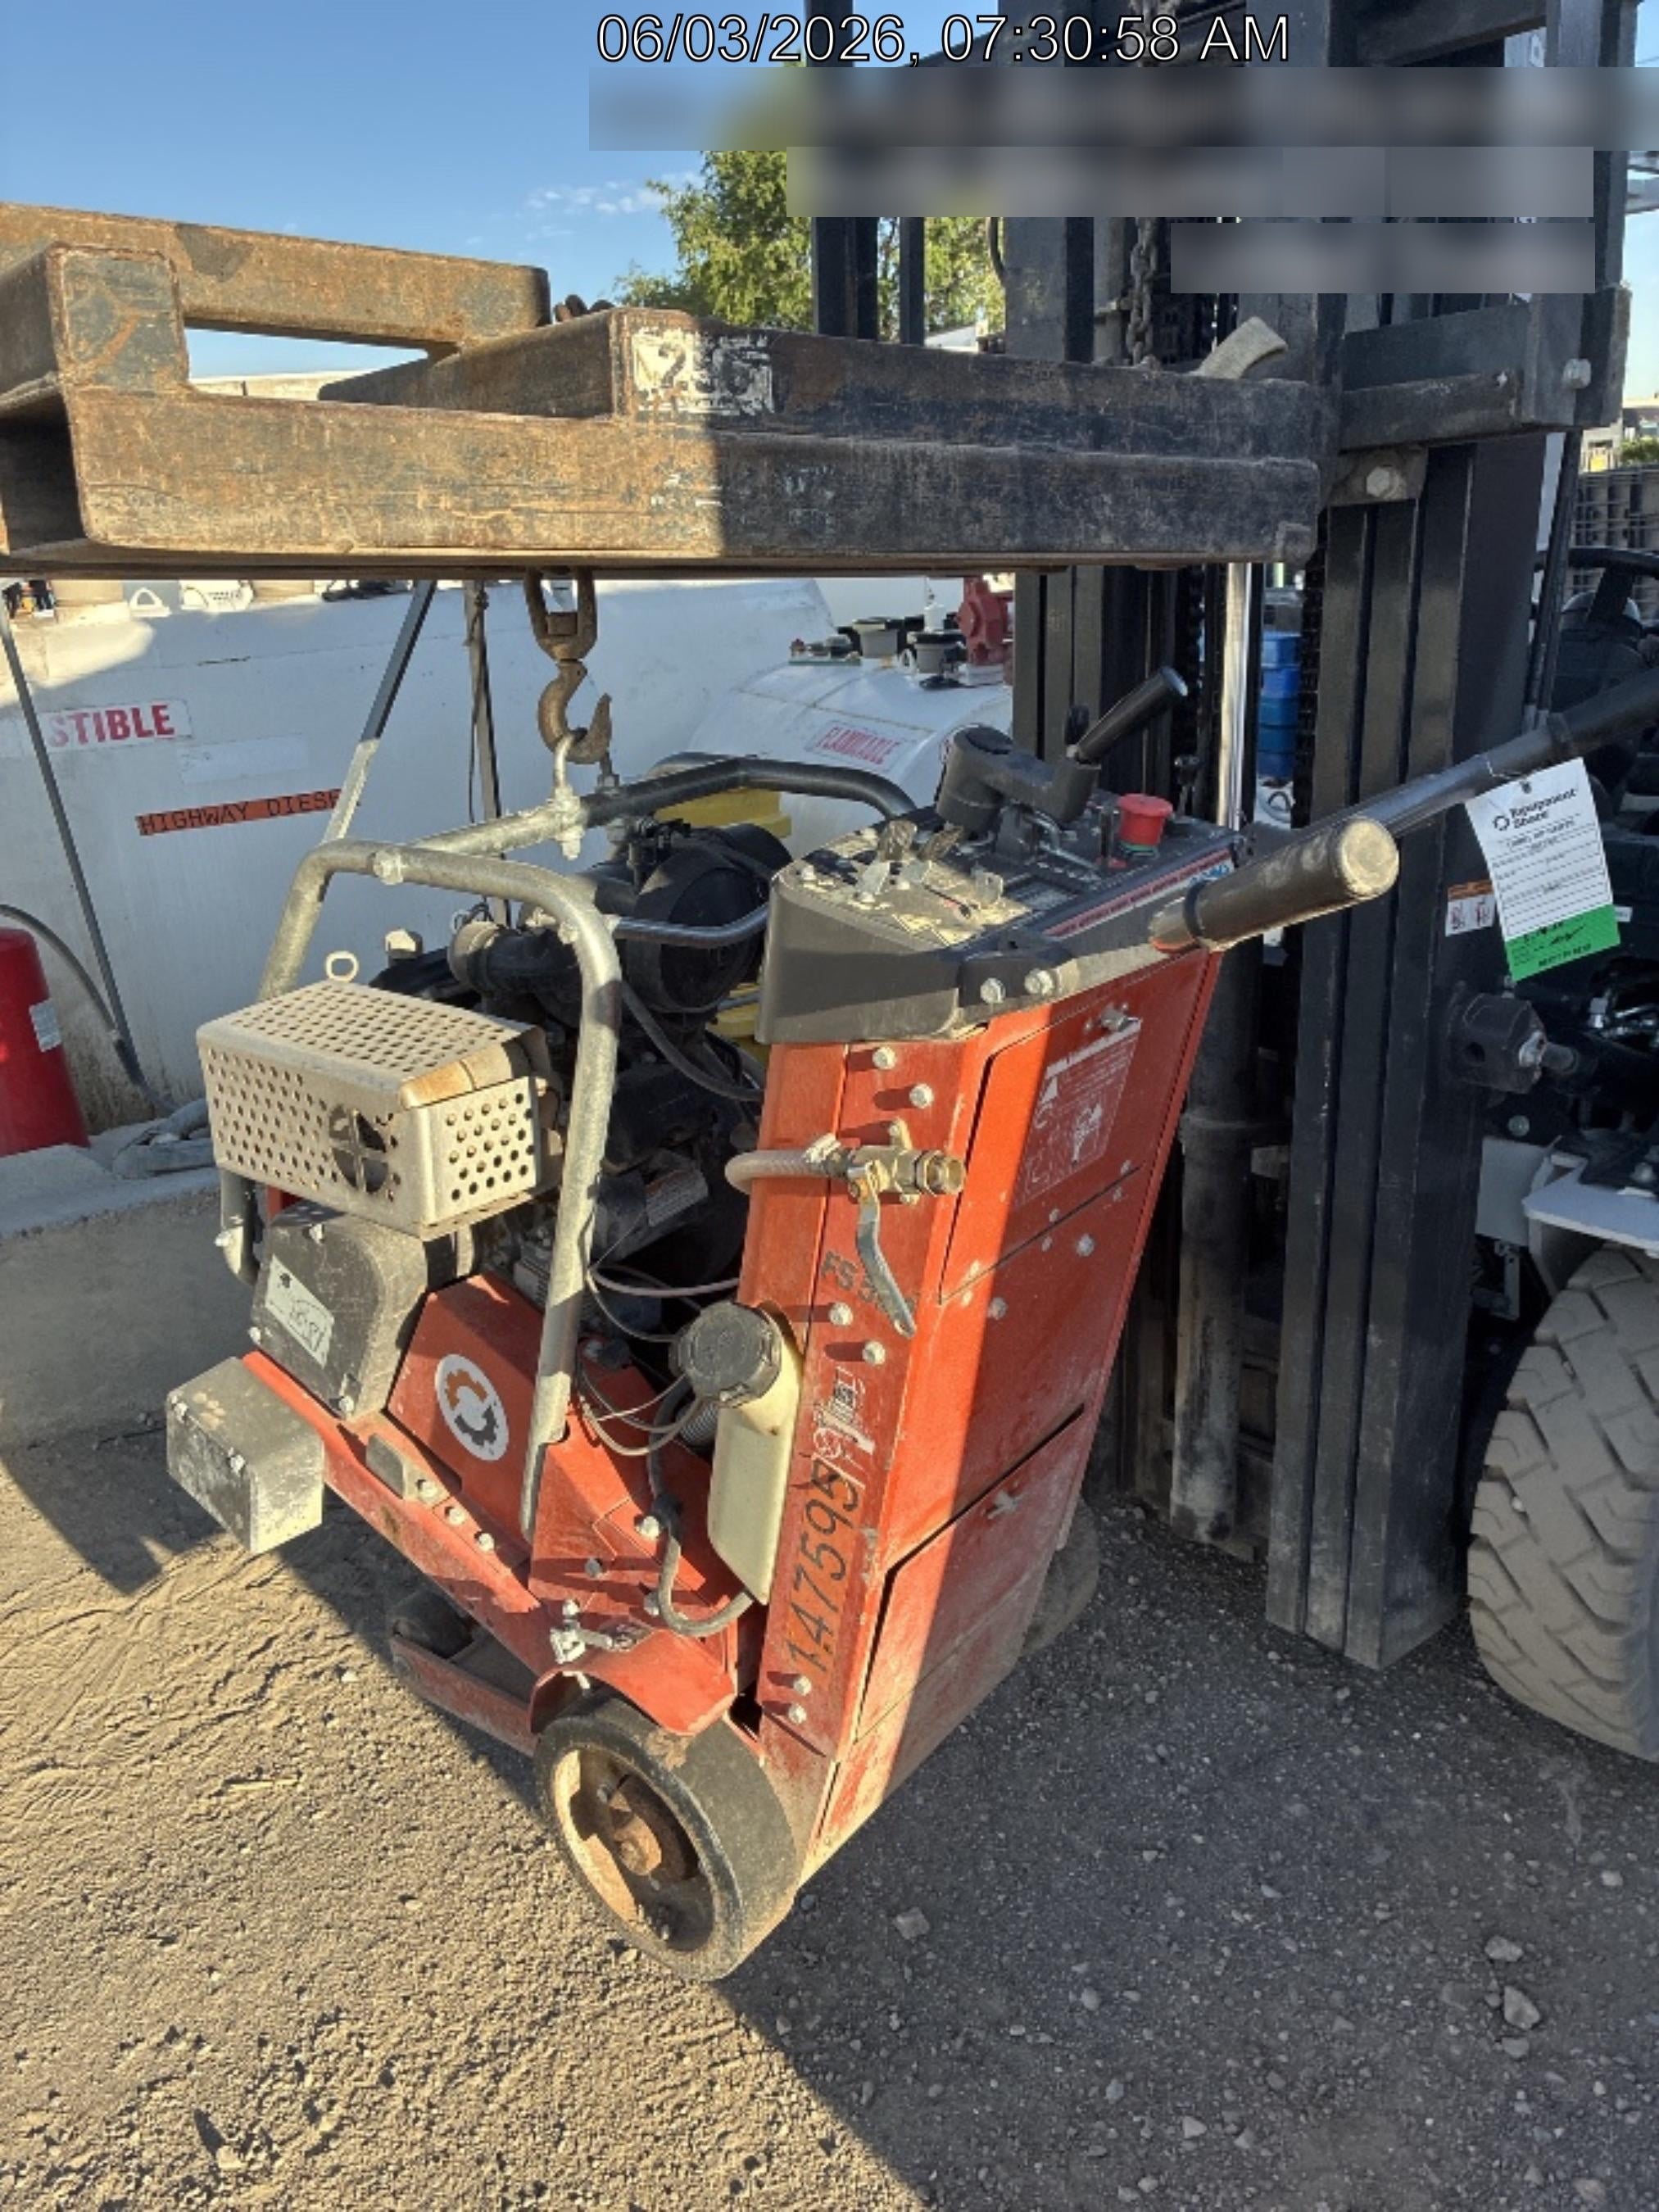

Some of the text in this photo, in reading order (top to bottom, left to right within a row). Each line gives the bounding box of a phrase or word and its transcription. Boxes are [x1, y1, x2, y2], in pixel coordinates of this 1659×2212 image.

[48, 705, 175, 748] STIBLE
[137, 788, 342, 836] HIGHWAY DIESE
